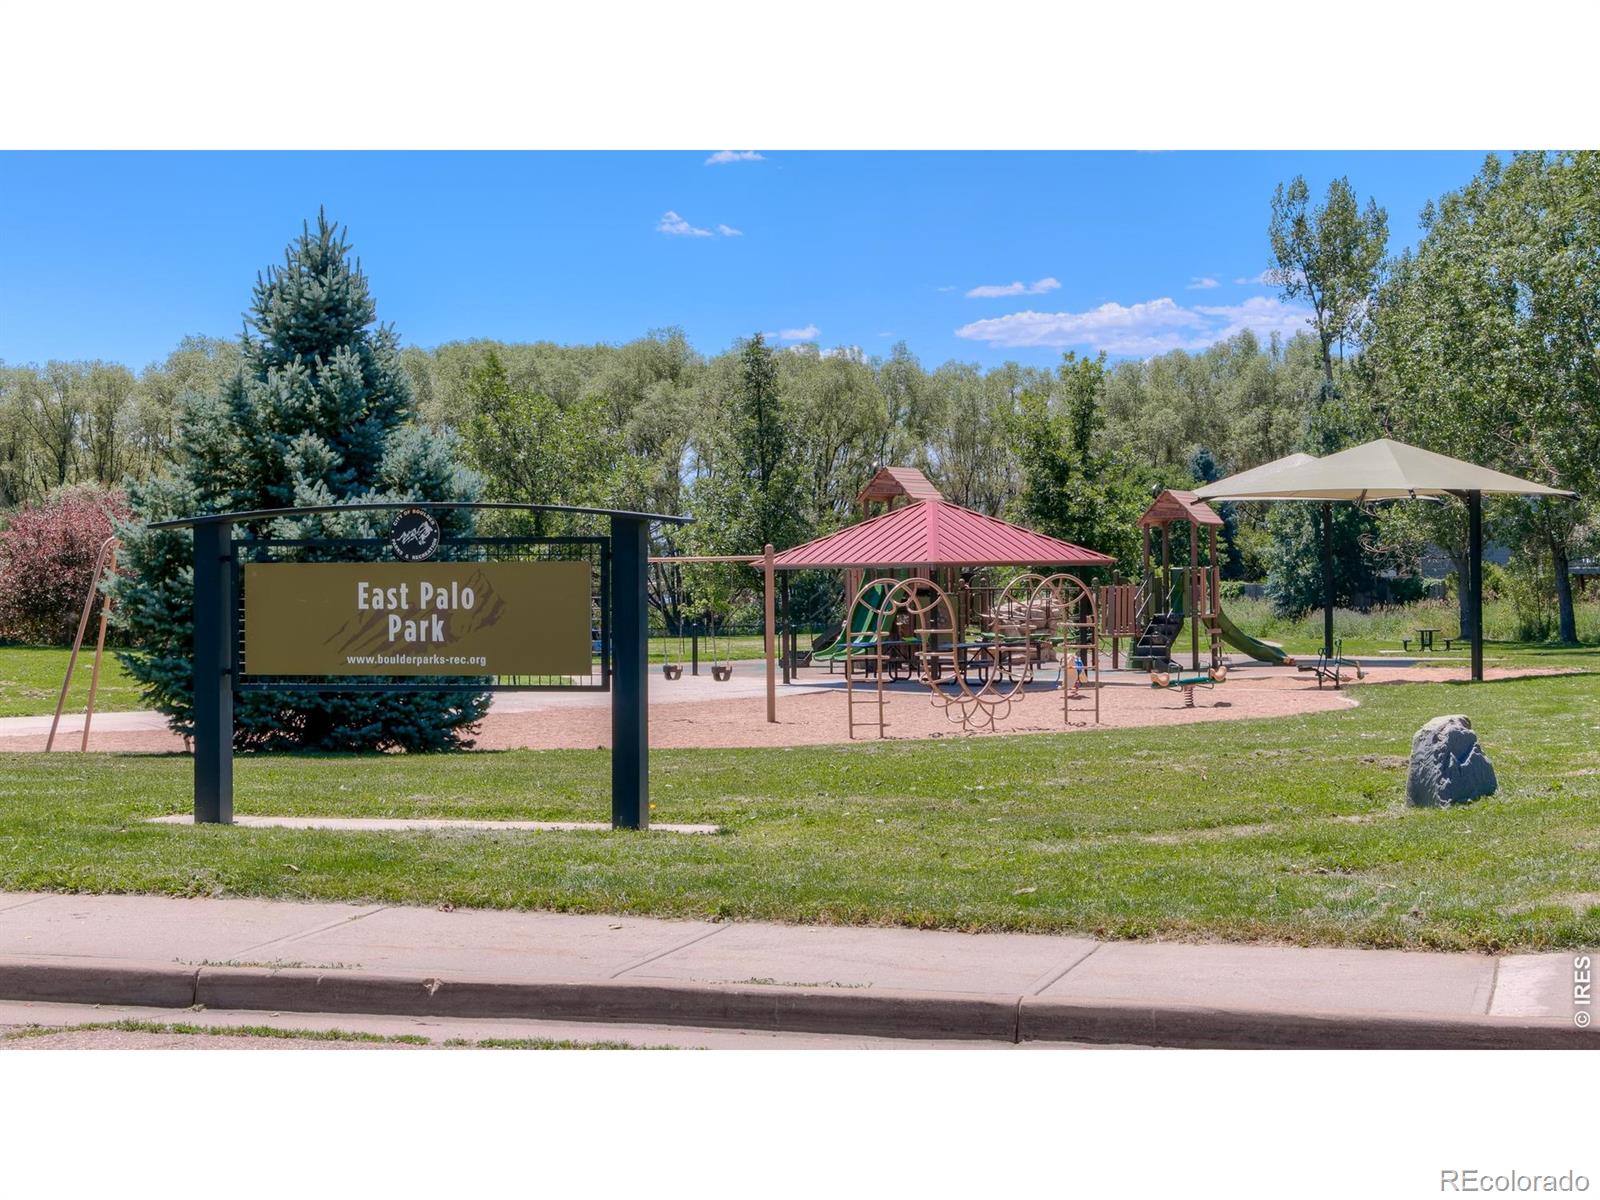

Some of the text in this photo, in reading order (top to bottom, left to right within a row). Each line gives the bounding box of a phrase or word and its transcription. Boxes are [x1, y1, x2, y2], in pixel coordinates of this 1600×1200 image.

[357, 581, 475, 610] East Palo
[388, 614, 445, 642] Park
[347, 655, 487, 667] www.boulderparks-rec.org
